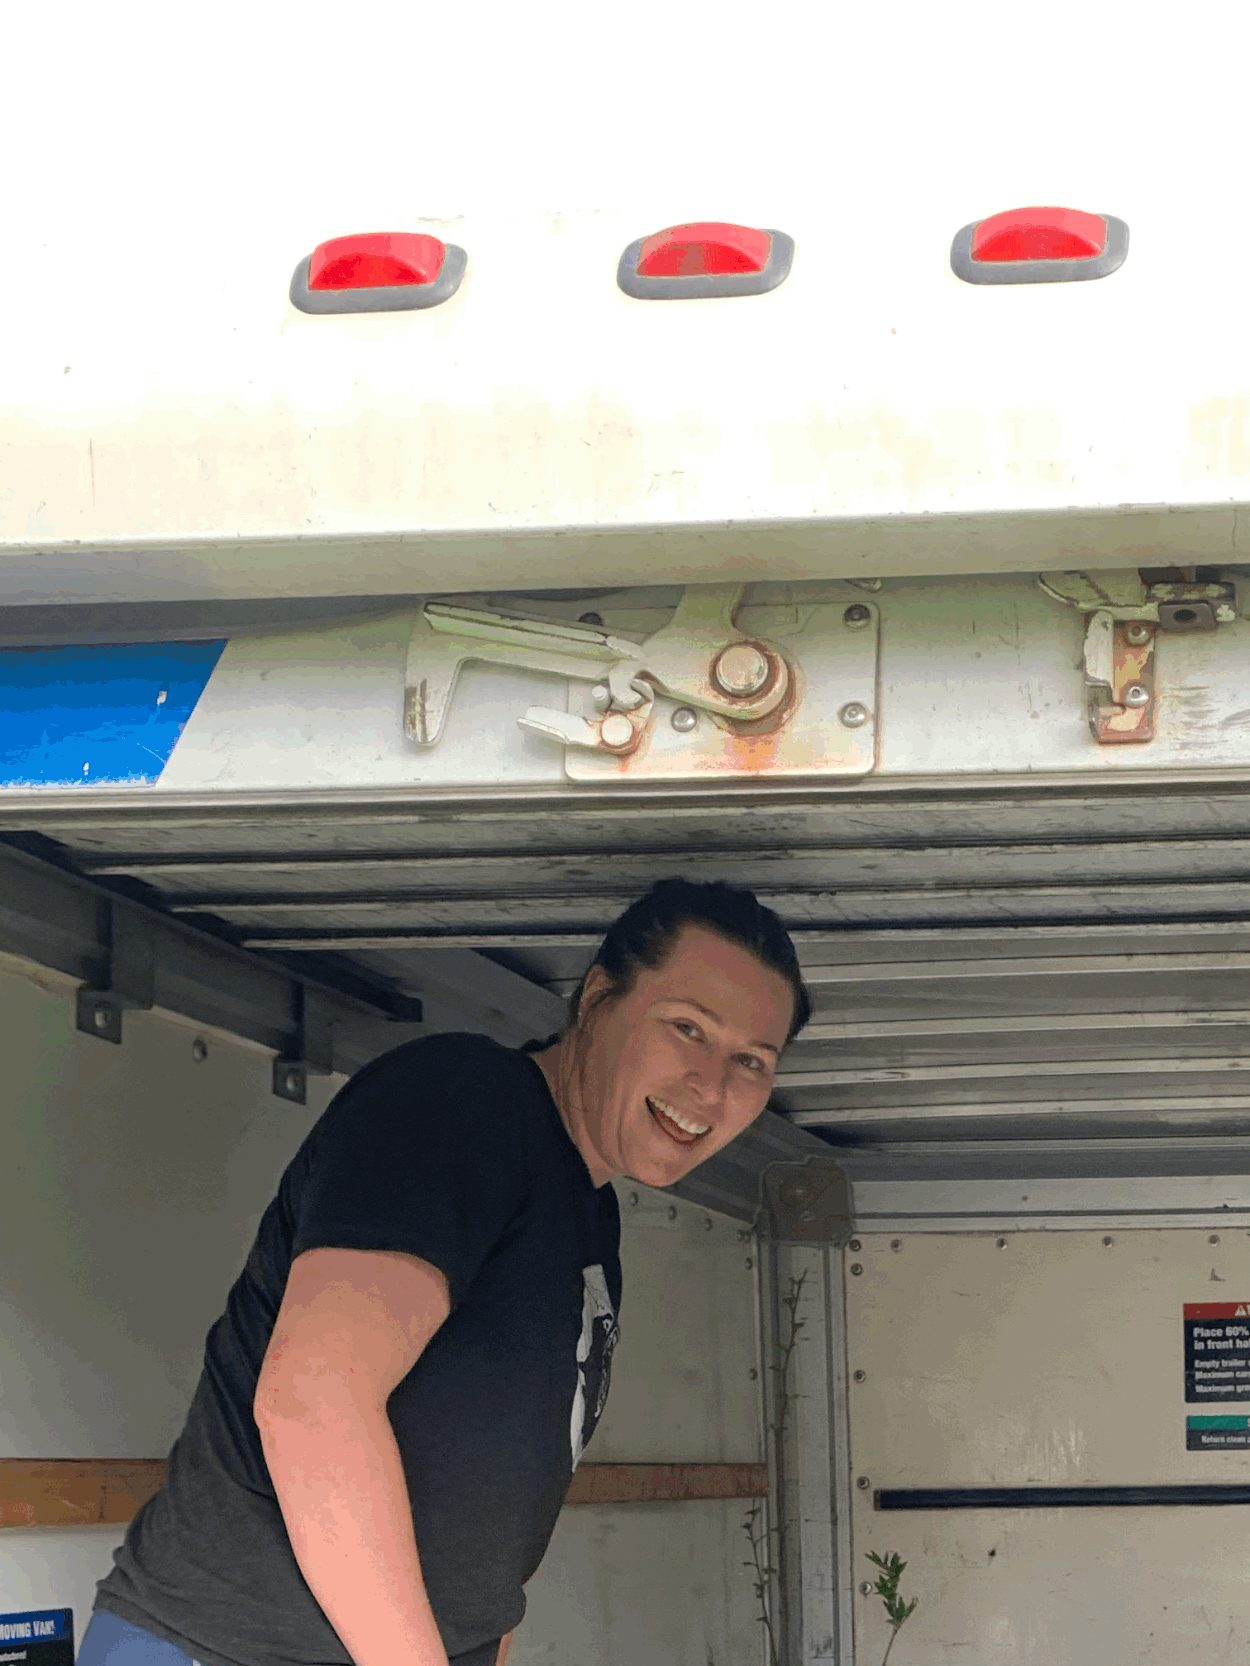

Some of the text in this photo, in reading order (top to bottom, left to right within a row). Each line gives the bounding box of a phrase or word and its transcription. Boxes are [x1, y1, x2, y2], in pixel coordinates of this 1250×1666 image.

[1193, 1327, 1223, 1338] Place
[1225, 1326, 1250, 1337] 60%
[1194, 1340, 1205, 1350] in
[1207, 1339, 1234, 1350] front
